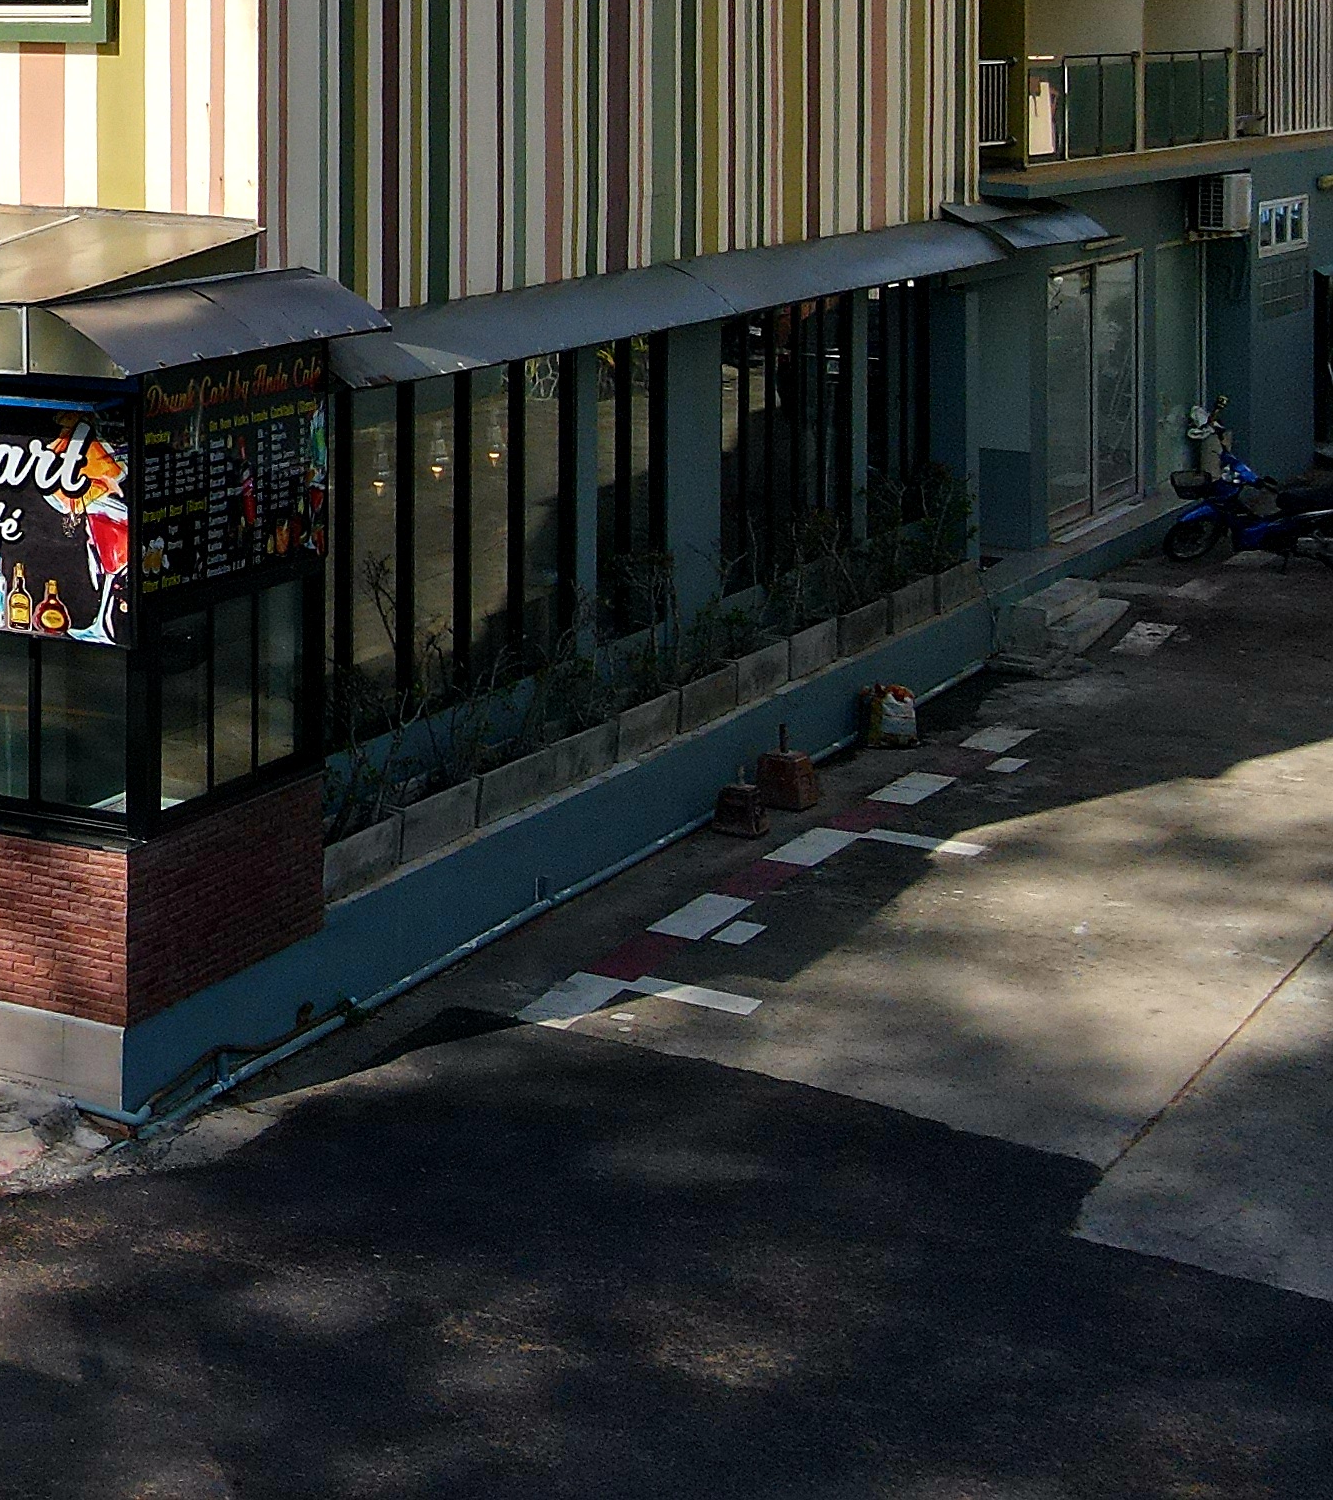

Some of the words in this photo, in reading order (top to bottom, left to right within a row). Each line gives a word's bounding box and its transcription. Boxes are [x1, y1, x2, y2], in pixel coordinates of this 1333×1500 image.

[145, 378, 196, 418] Drunk
[199, 370, 232, 407] Cart
[234, 369, 250, 400] by
[252, 362, 289, 395] Anda
